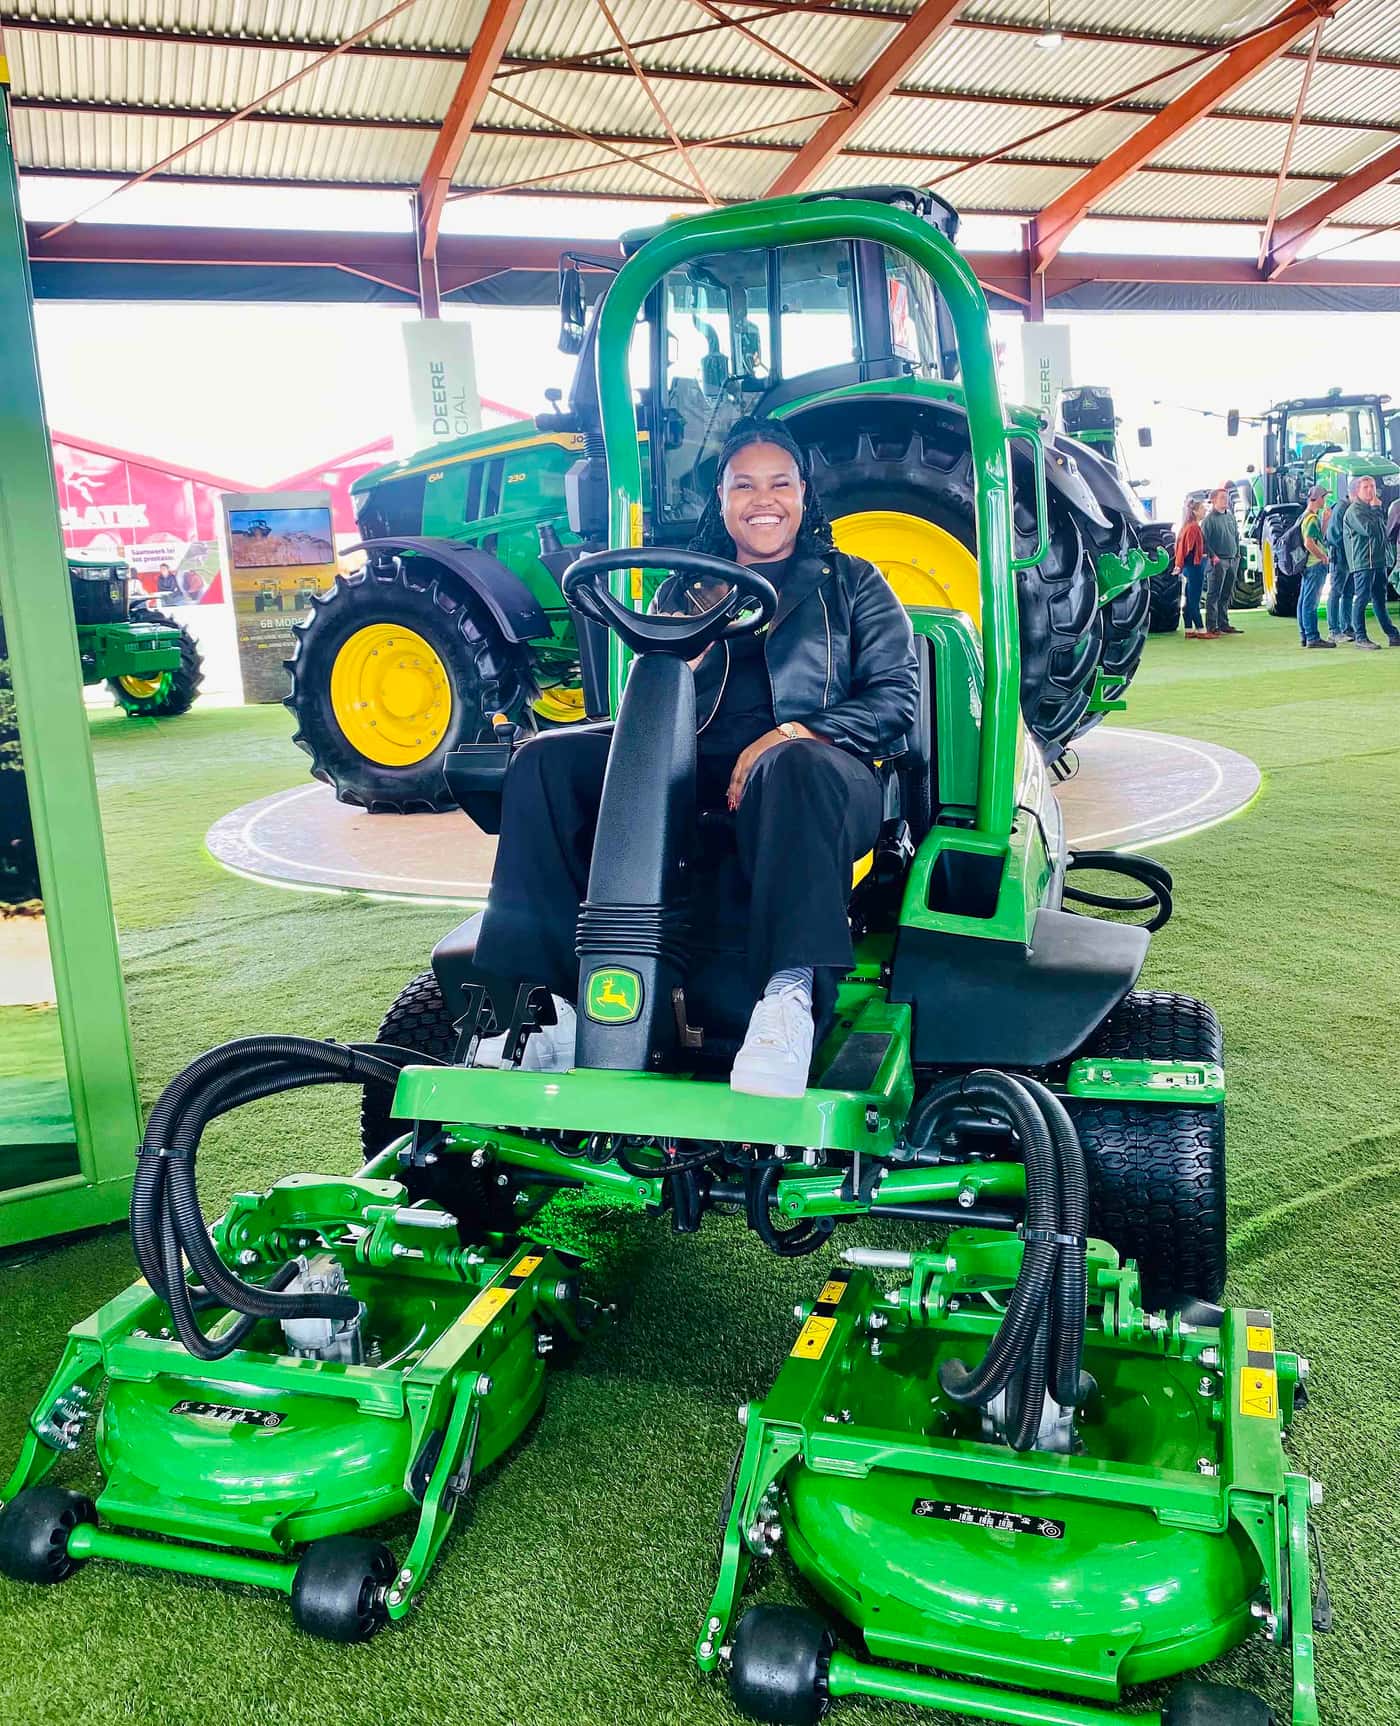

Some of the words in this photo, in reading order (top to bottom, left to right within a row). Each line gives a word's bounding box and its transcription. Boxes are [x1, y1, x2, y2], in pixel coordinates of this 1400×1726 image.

[430, 361, 449, 434] DEERE
[452, 386, 469, 435] CIAL
[428, 471, 444, 483] 6M
[507, 472, 527, 484] 230
